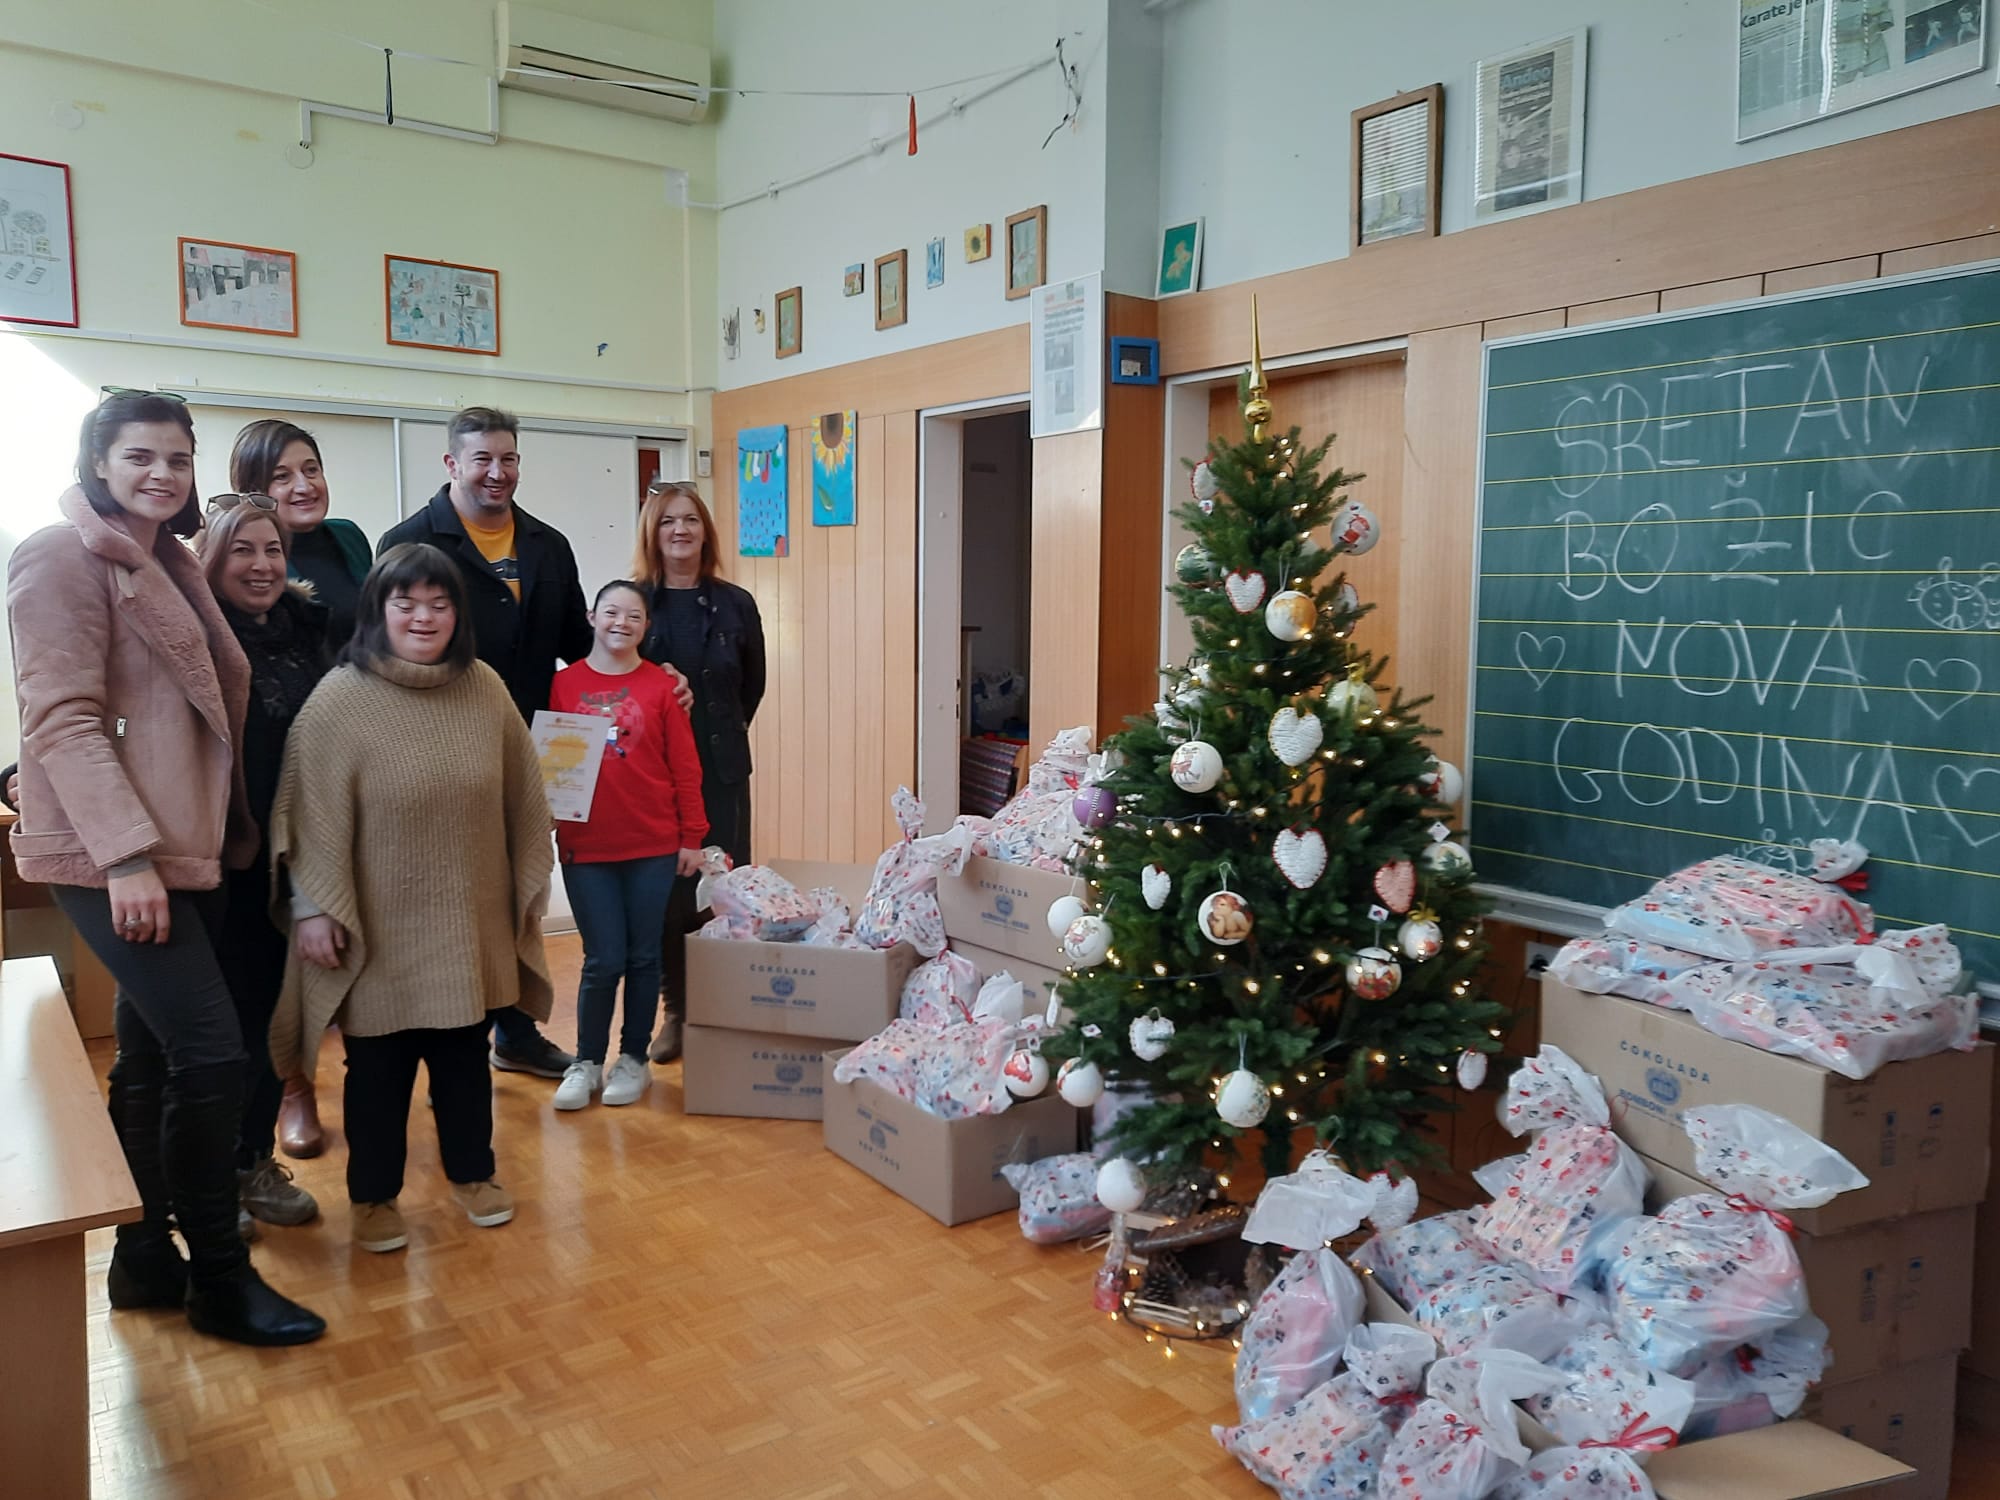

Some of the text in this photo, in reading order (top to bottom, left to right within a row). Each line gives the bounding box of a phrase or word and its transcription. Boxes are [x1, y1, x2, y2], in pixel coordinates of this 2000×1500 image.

[1551, 345, 1929, 498] SRETAN
[1615, 607, 1869, 712] NOVA
[1553, 717, 1919, 863] GODINA
